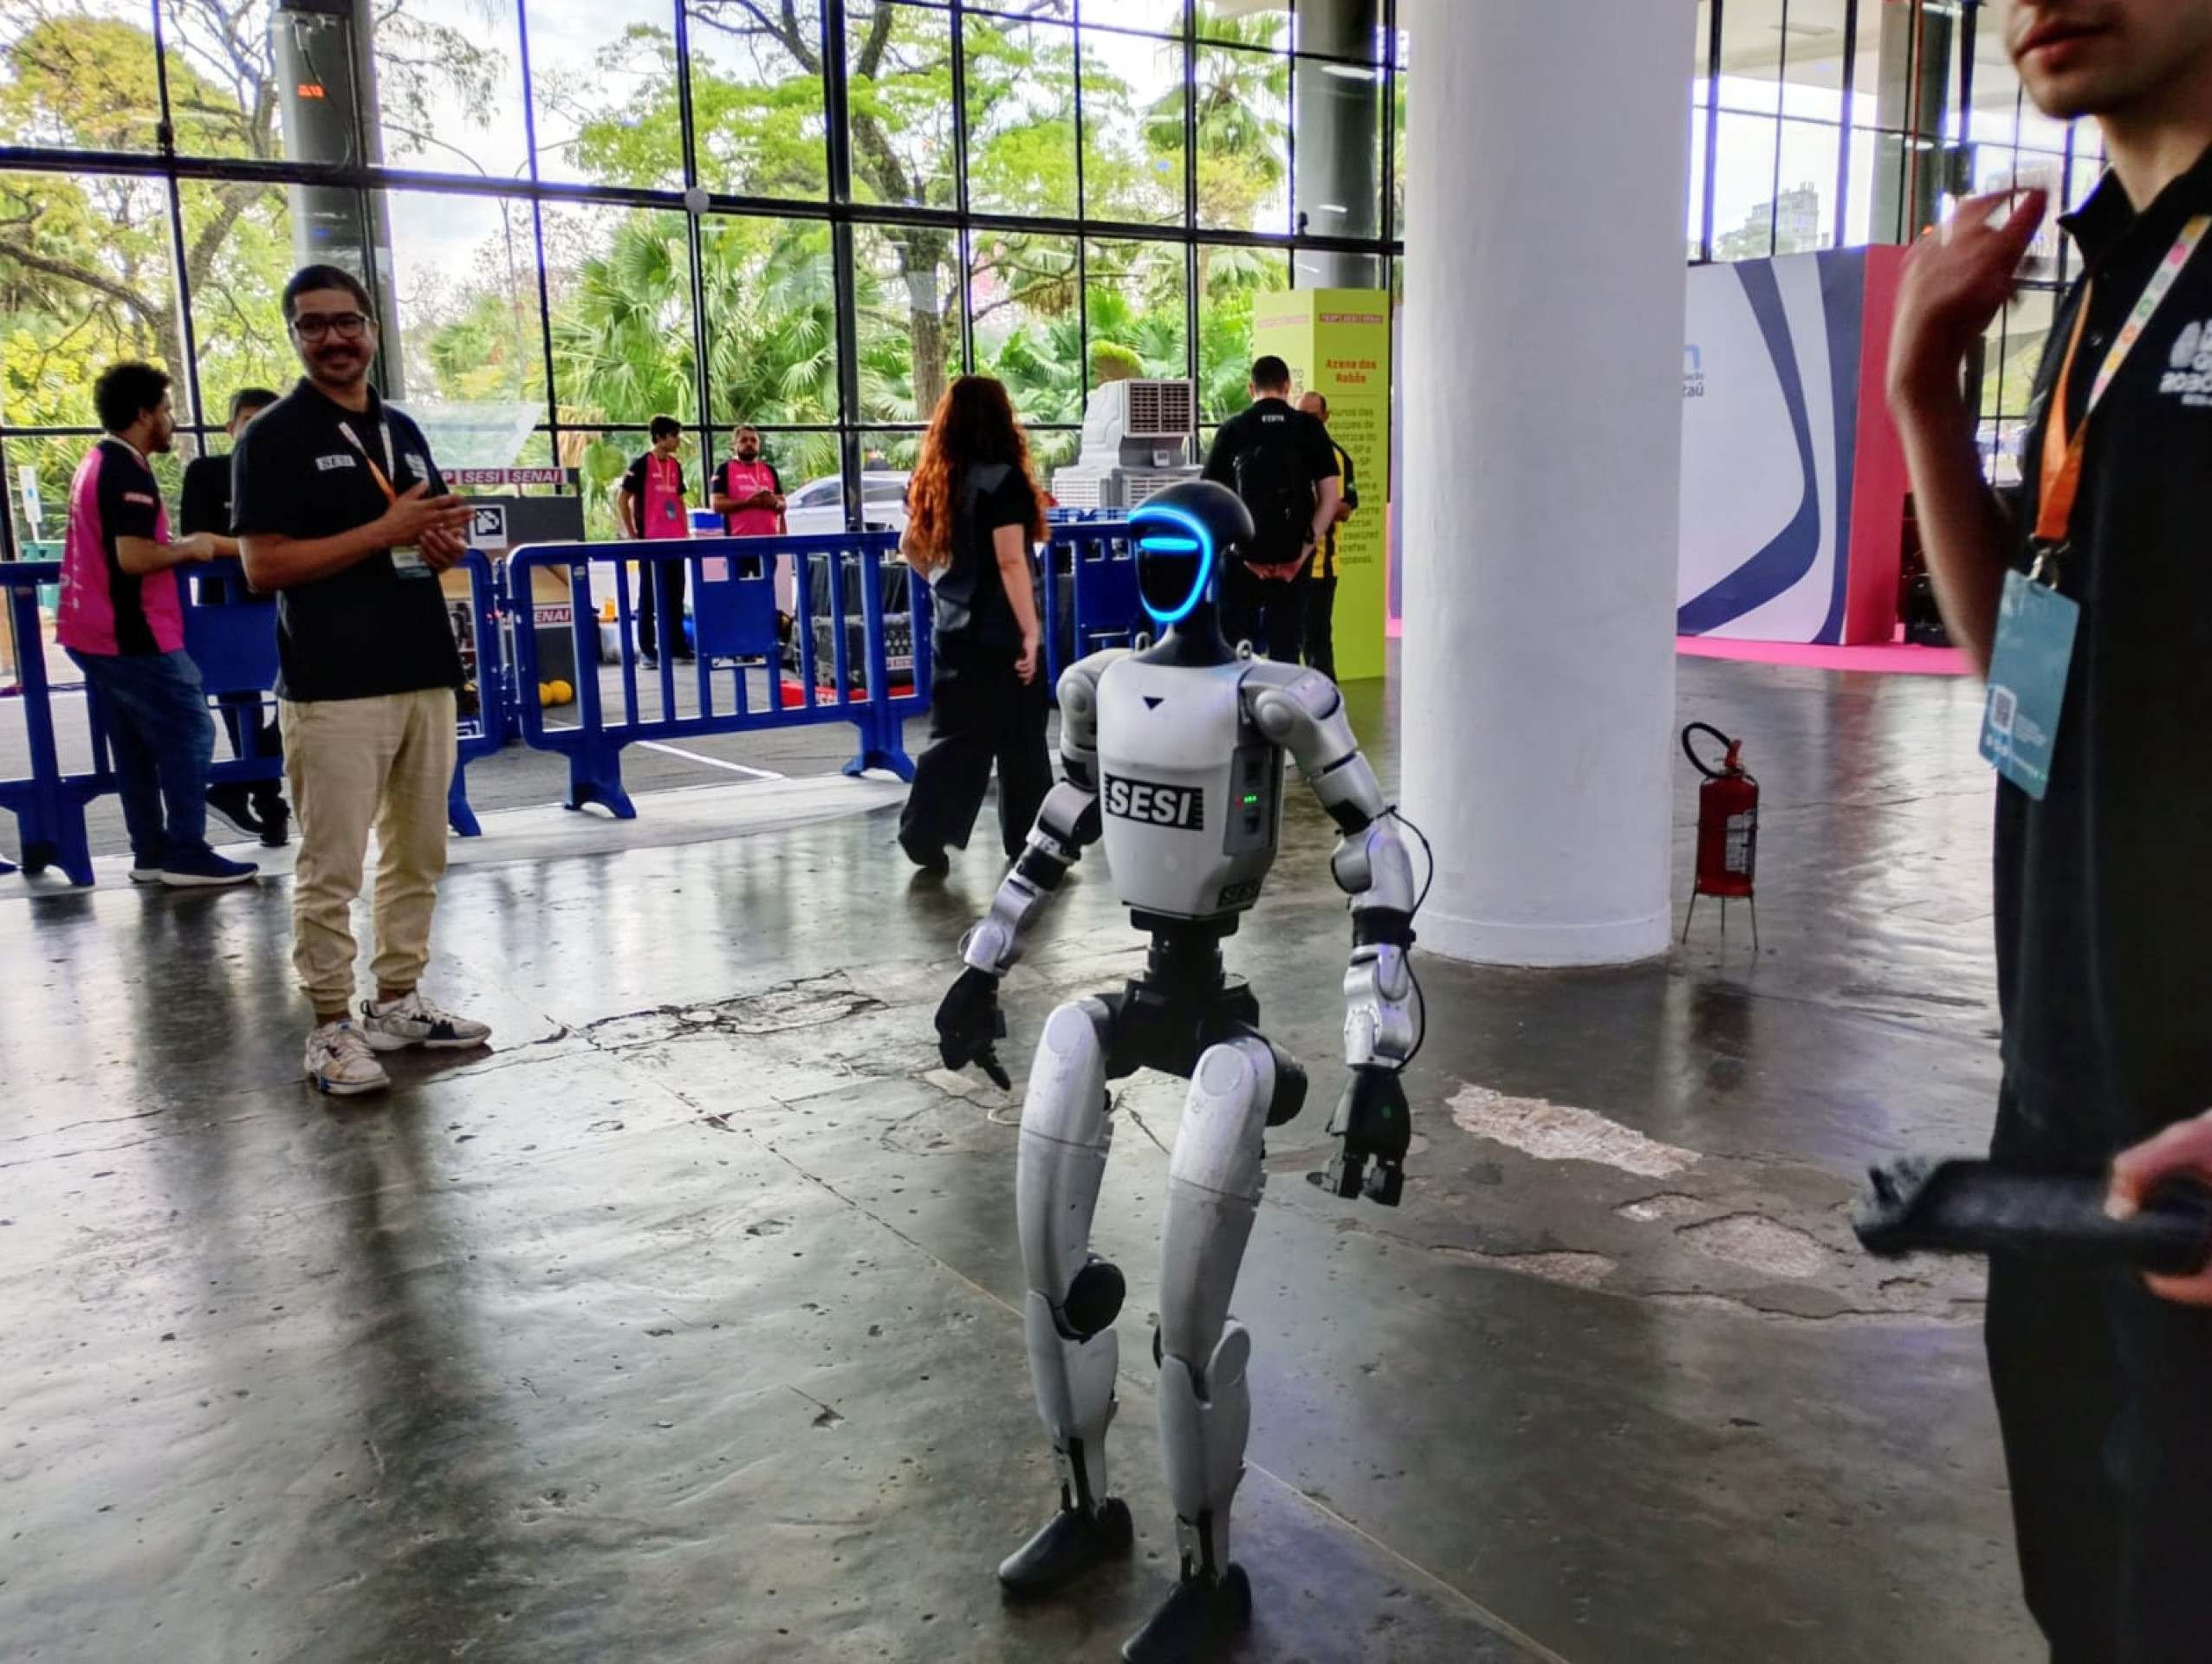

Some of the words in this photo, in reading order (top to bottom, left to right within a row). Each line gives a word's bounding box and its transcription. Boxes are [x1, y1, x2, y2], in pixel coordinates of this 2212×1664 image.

[464, 469, 500, 483] SESI
[512, 469, 558, 483] SENAI
[535, 609, 570, 623] ENAI
[1109, 780, 1192, 826] SESI
